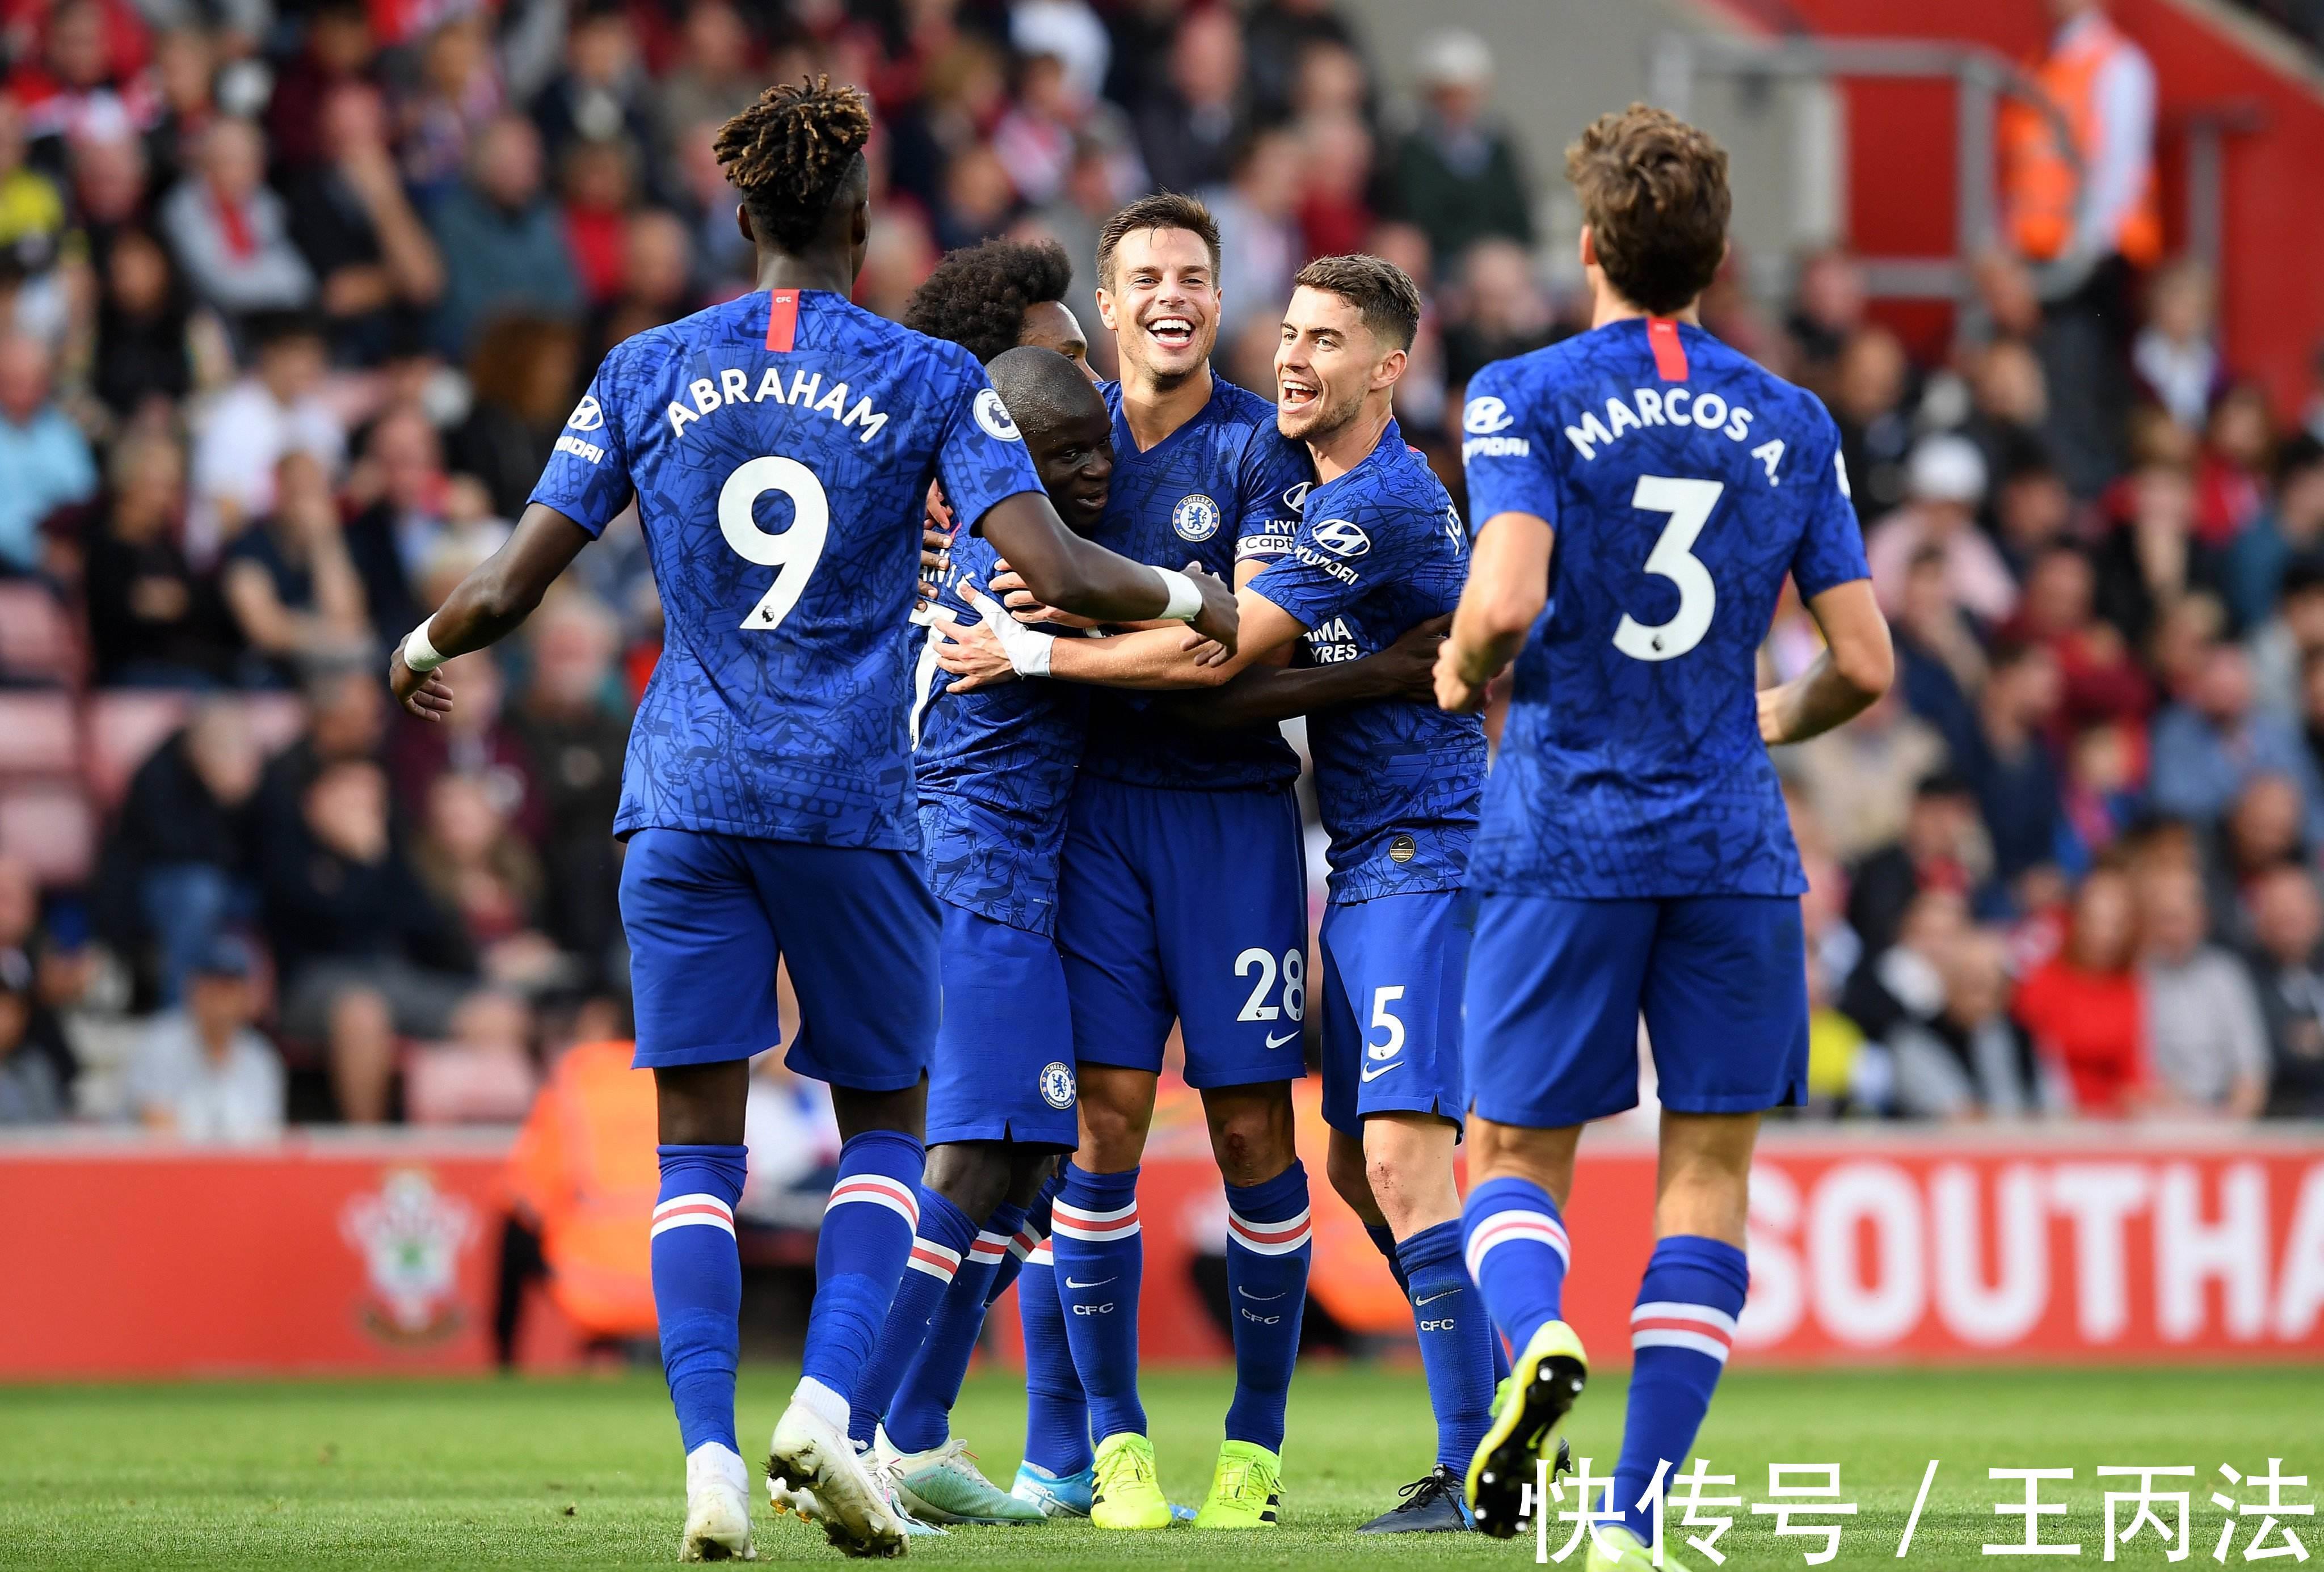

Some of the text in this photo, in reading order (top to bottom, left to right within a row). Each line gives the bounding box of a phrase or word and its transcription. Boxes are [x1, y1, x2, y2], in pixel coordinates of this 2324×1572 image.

[668, 368, 889, 443] ABRAHAM
[1564, 387, 1754, 460] MARCOS
[1183, 496, 1212, 508] CHELSEA
[718, 456, 830, 630] 9
[1612, 474, 1725, 662] 3
[1234, 947, 1304, 1021] 28
[1367, 985, 1406, 1060] 5
[1072, 1303, 1114, 1316] CFC
[1241, 1308, 1279, 1325] CFC
[1420, 1319, 1454, 1331] CFC
